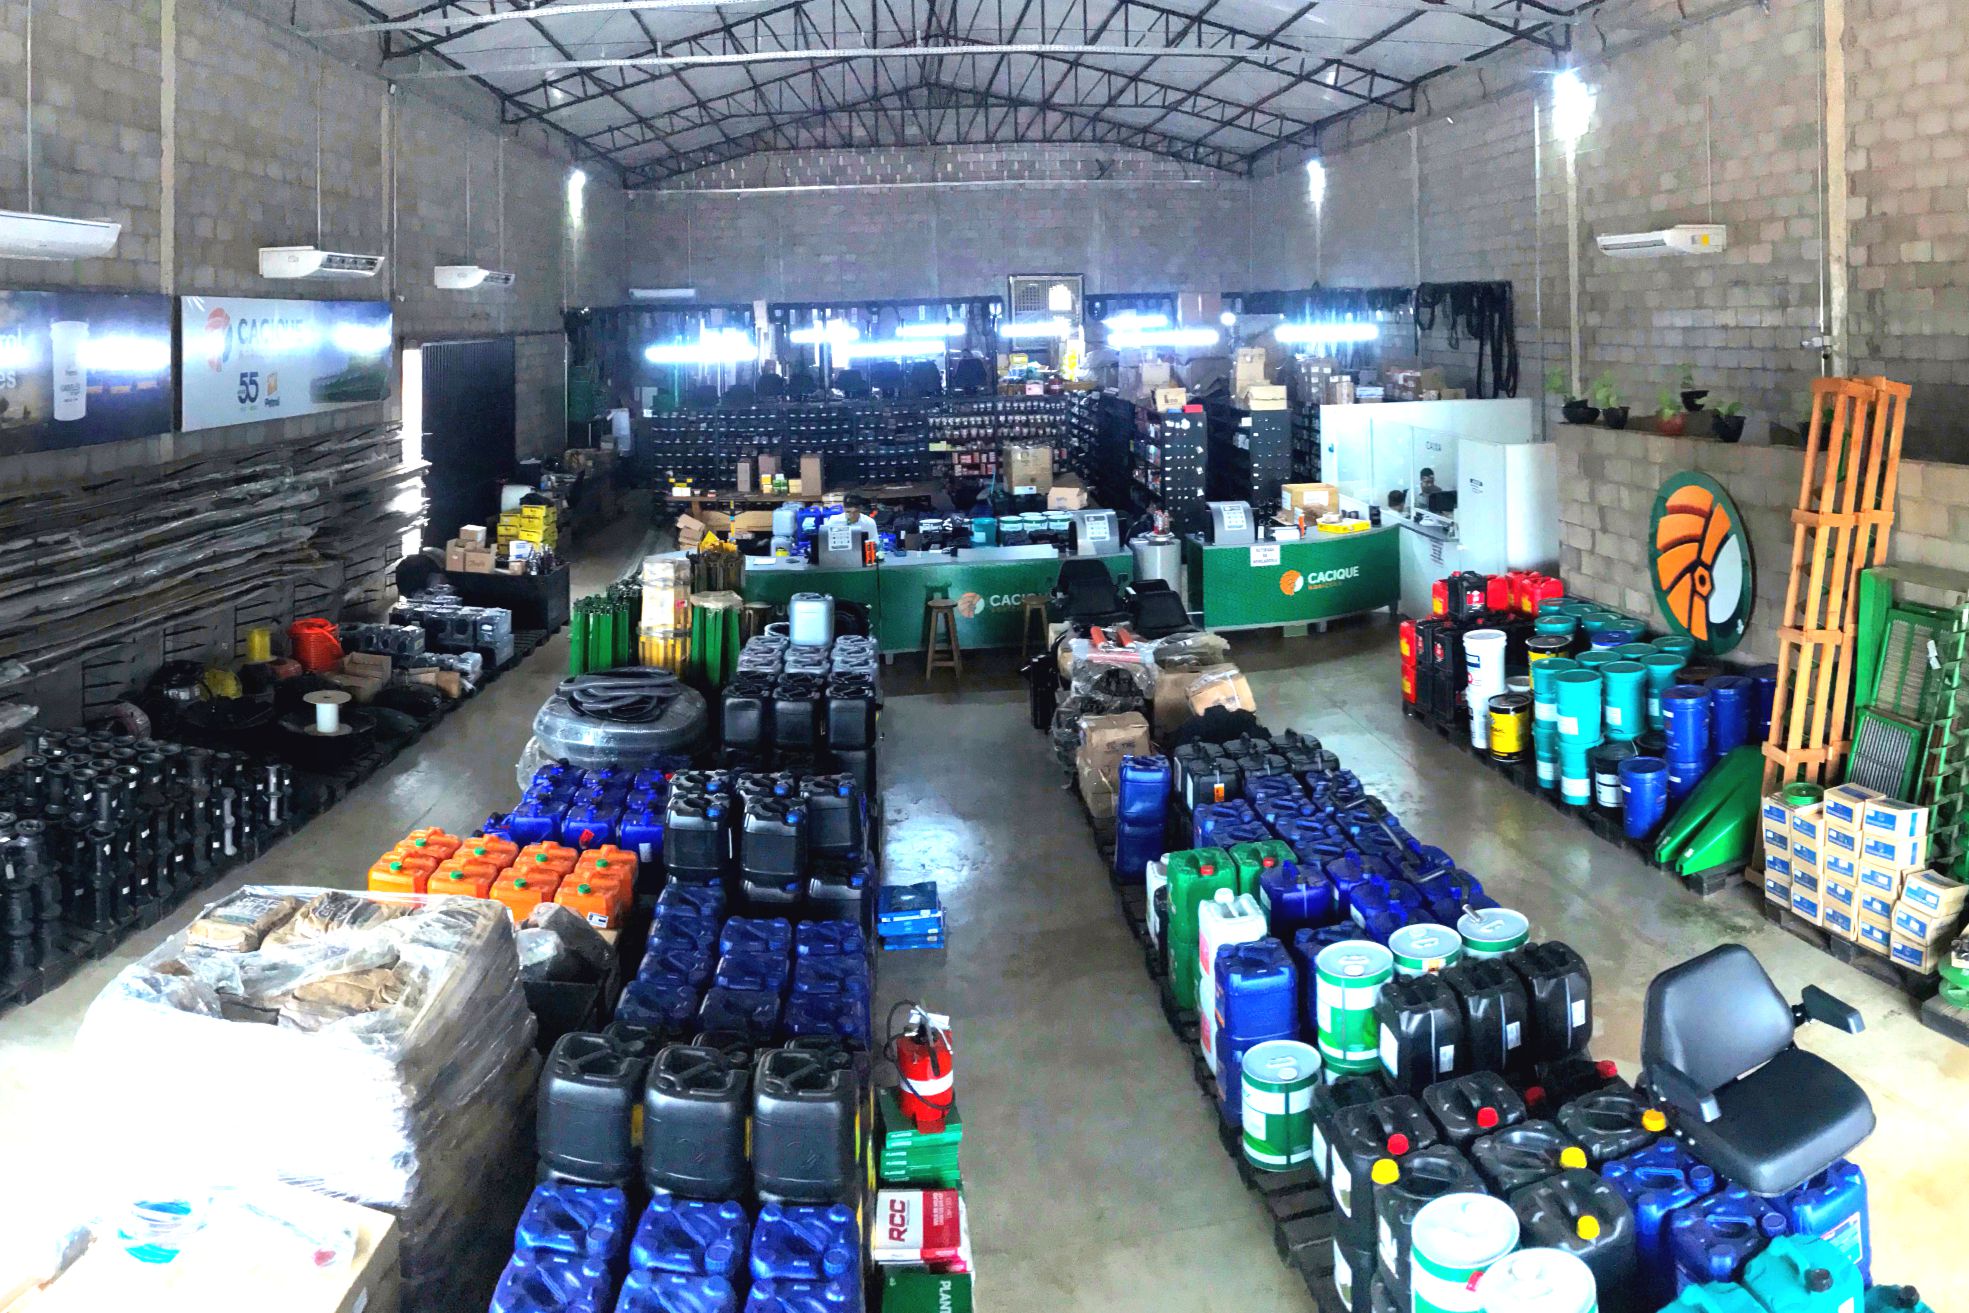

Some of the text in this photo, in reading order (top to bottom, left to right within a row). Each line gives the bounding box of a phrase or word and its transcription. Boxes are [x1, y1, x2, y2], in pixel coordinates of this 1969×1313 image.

[237, 371, 259, 404] 55
[1307, 565, 1360, 584] CACIQUE
[888, 1198, 908, 1242] RCC
